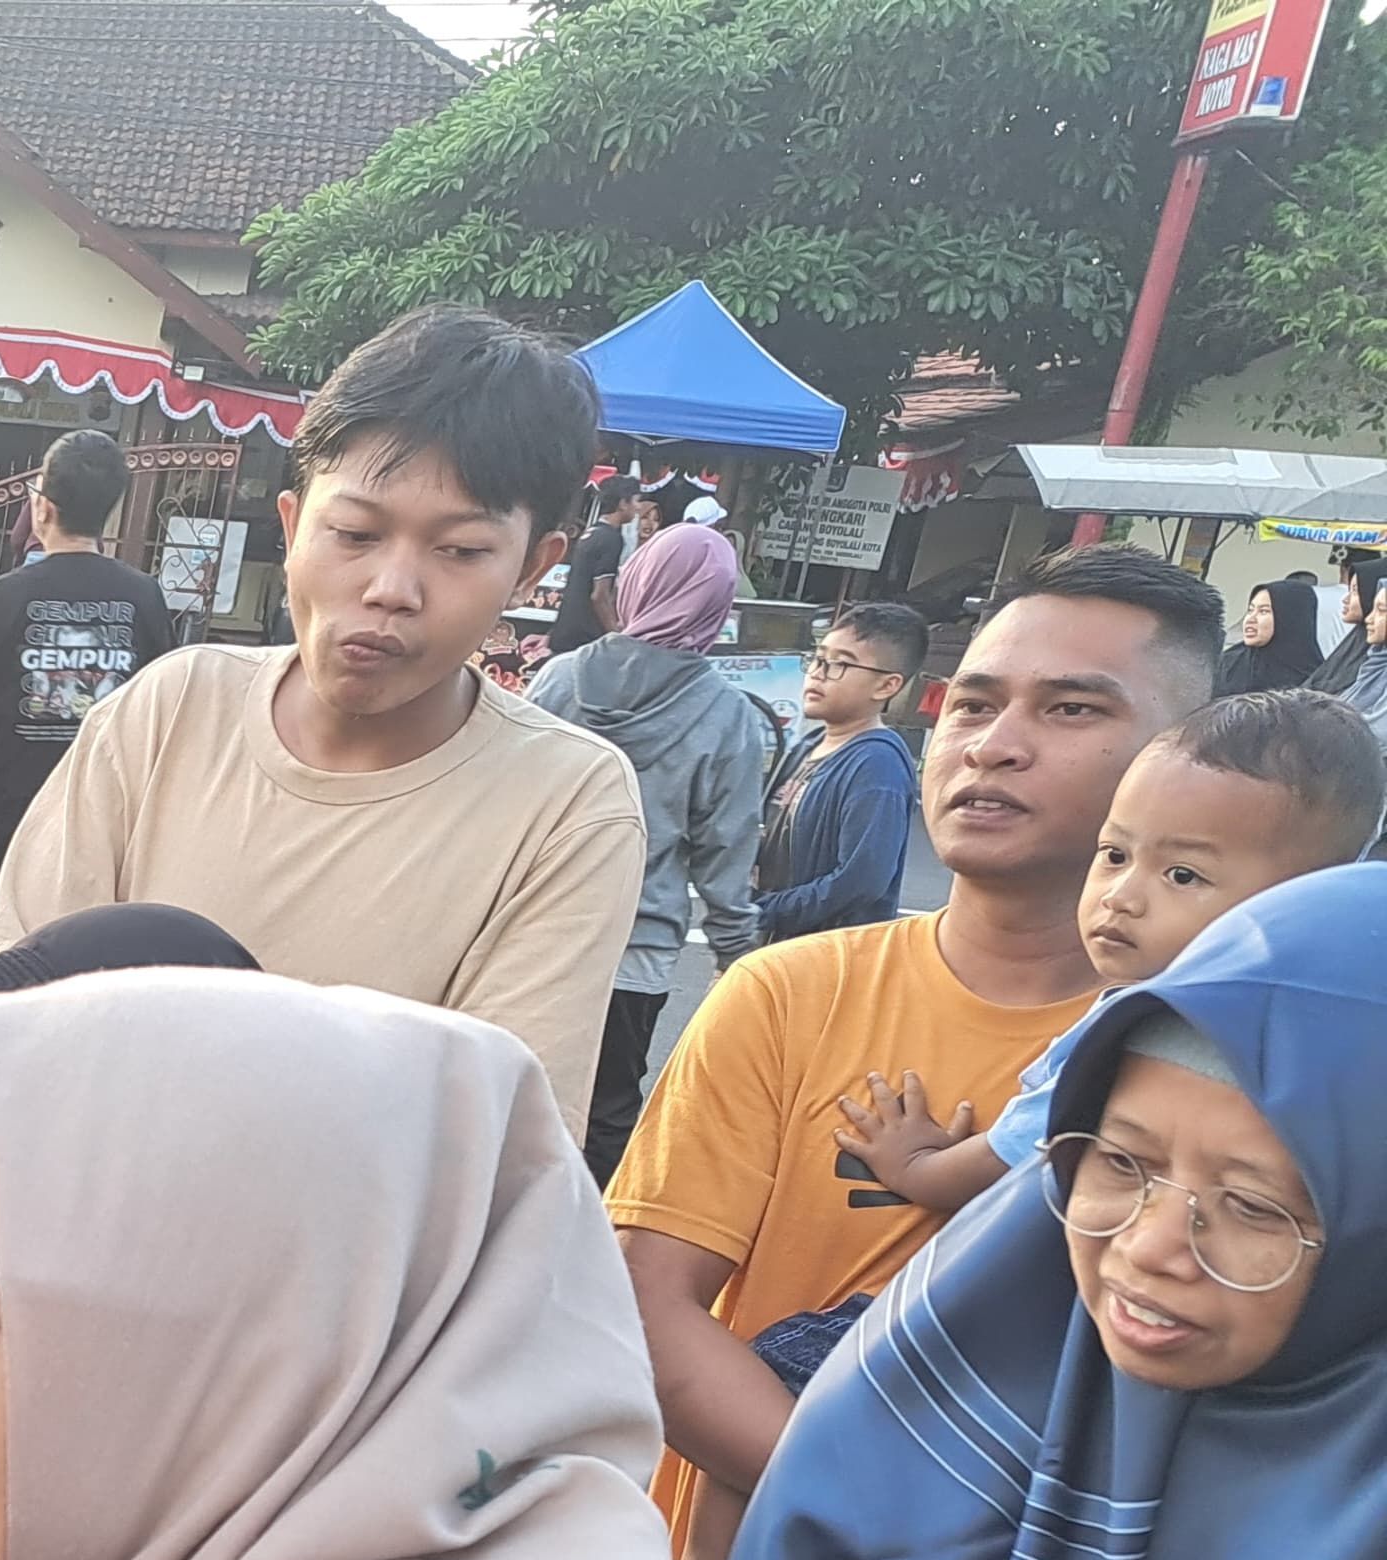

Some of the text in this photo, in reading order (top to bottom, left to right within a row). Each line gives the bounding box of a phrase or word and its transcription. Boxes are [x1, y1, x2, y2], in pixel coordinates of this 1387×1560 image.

[867, 501, 892, 514] POLRI
[818, 524, 865, 539] BOYOLALI
[1332, 529, 1380, 544] AYAM
[826, 537, 862, 551] BOYOLALI
[862, 541, 882, 554] KOTA
[27, 600, 137, 624] GEMPUR
[21, 648, 132, 672] GEMPUR
